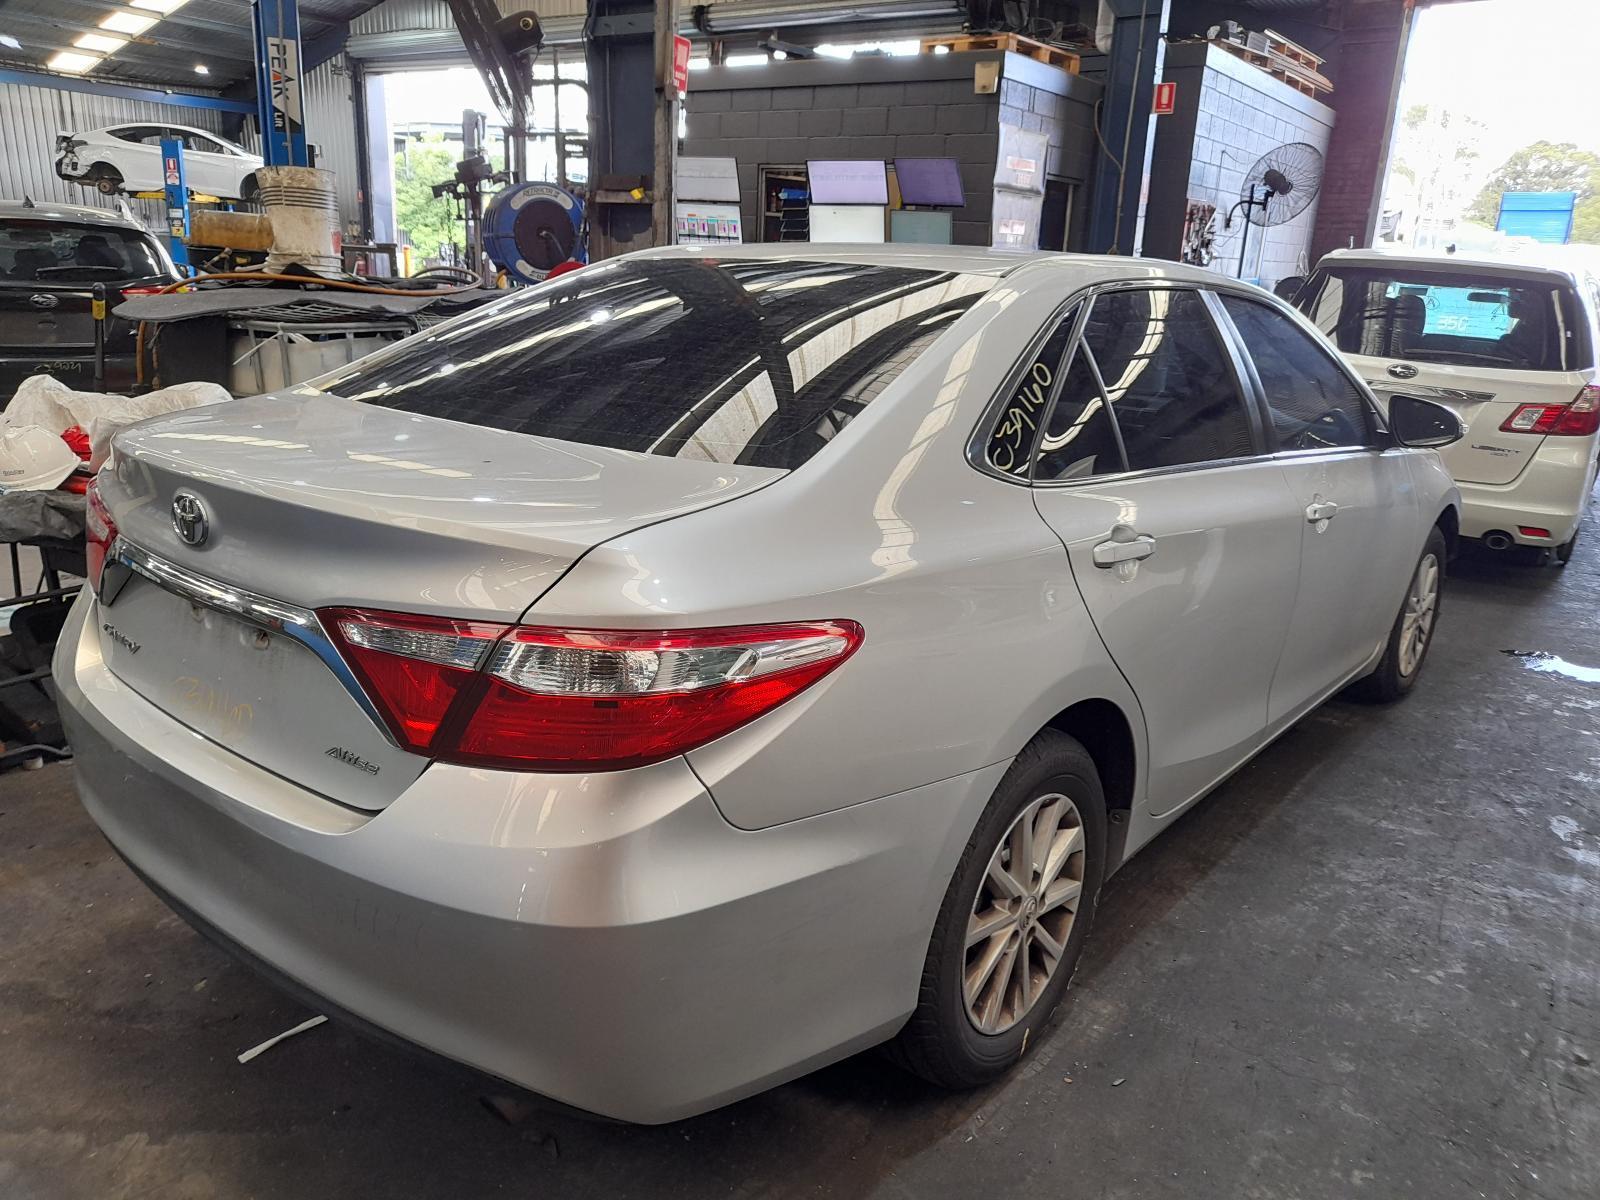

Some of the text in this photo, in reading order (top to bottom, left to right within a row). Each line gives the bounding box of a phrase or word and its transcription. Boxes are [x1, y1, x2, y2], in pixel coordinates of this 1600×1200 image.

[270, 43, 296, 100] PEAK
[993, 363, 1052, 470] C39160
[325, 747, 380, 775] Altise
